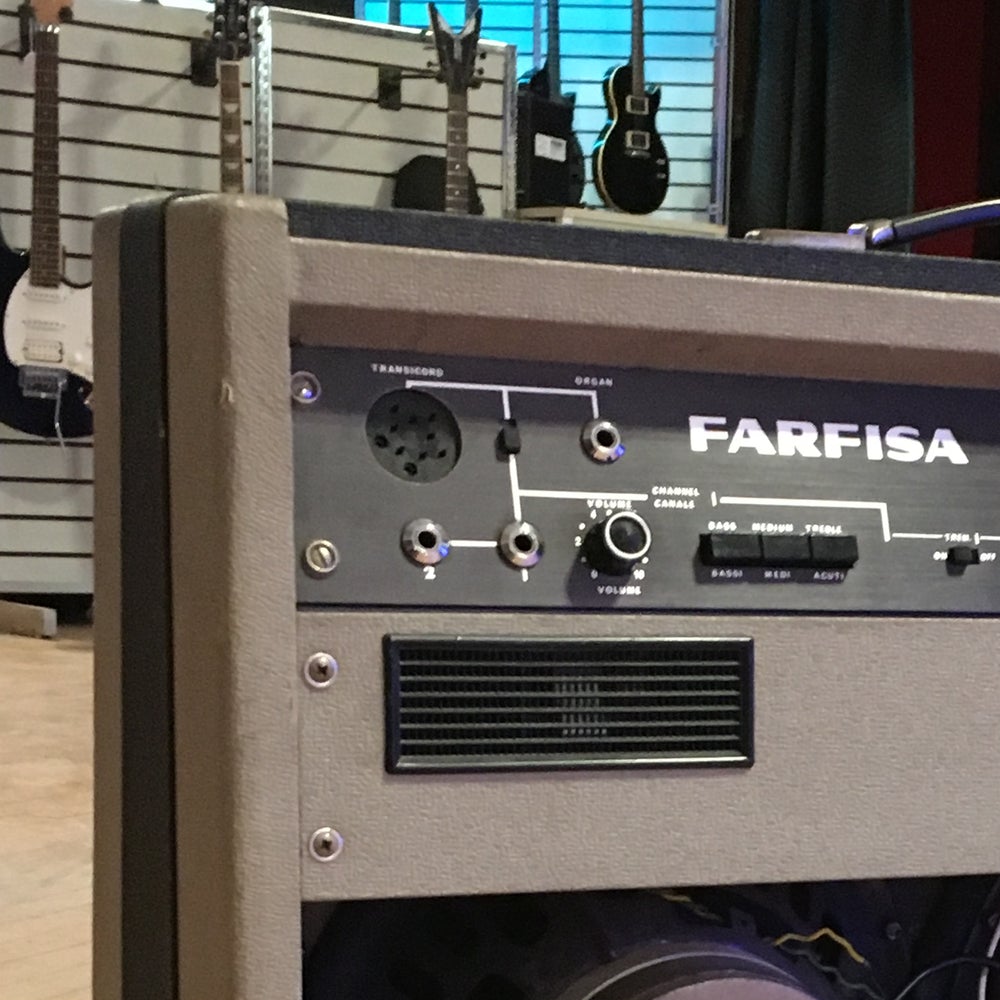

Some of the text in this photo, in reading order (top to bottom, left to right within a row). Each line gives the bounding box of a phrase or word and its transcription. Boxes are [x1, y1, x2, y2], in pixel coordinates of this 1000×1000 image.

[574, 376, 614, 388] ORGAN
[688, 414, 970, 465] FARFISA
[651, 486, 700, 497] CHANNEL
[587, 499, 632, 509] VOLUME
[708, 521, 737, 531] BASS
[752, 522, 794, 532] MEDIUM
[574, 536, 582, 547] 2
[933, 551, 948, 560] ON
[980, 552, 996, 562] OFF
[423, 566, 436, 580] 2
[521, 568, 529, 582] 1
[633, 569, 645, 580] 10
[764, 570, 791, 579] MEDI
[813, 571, 845, 581] ACUTI
[597, 586, 641, 595] VOLUME
